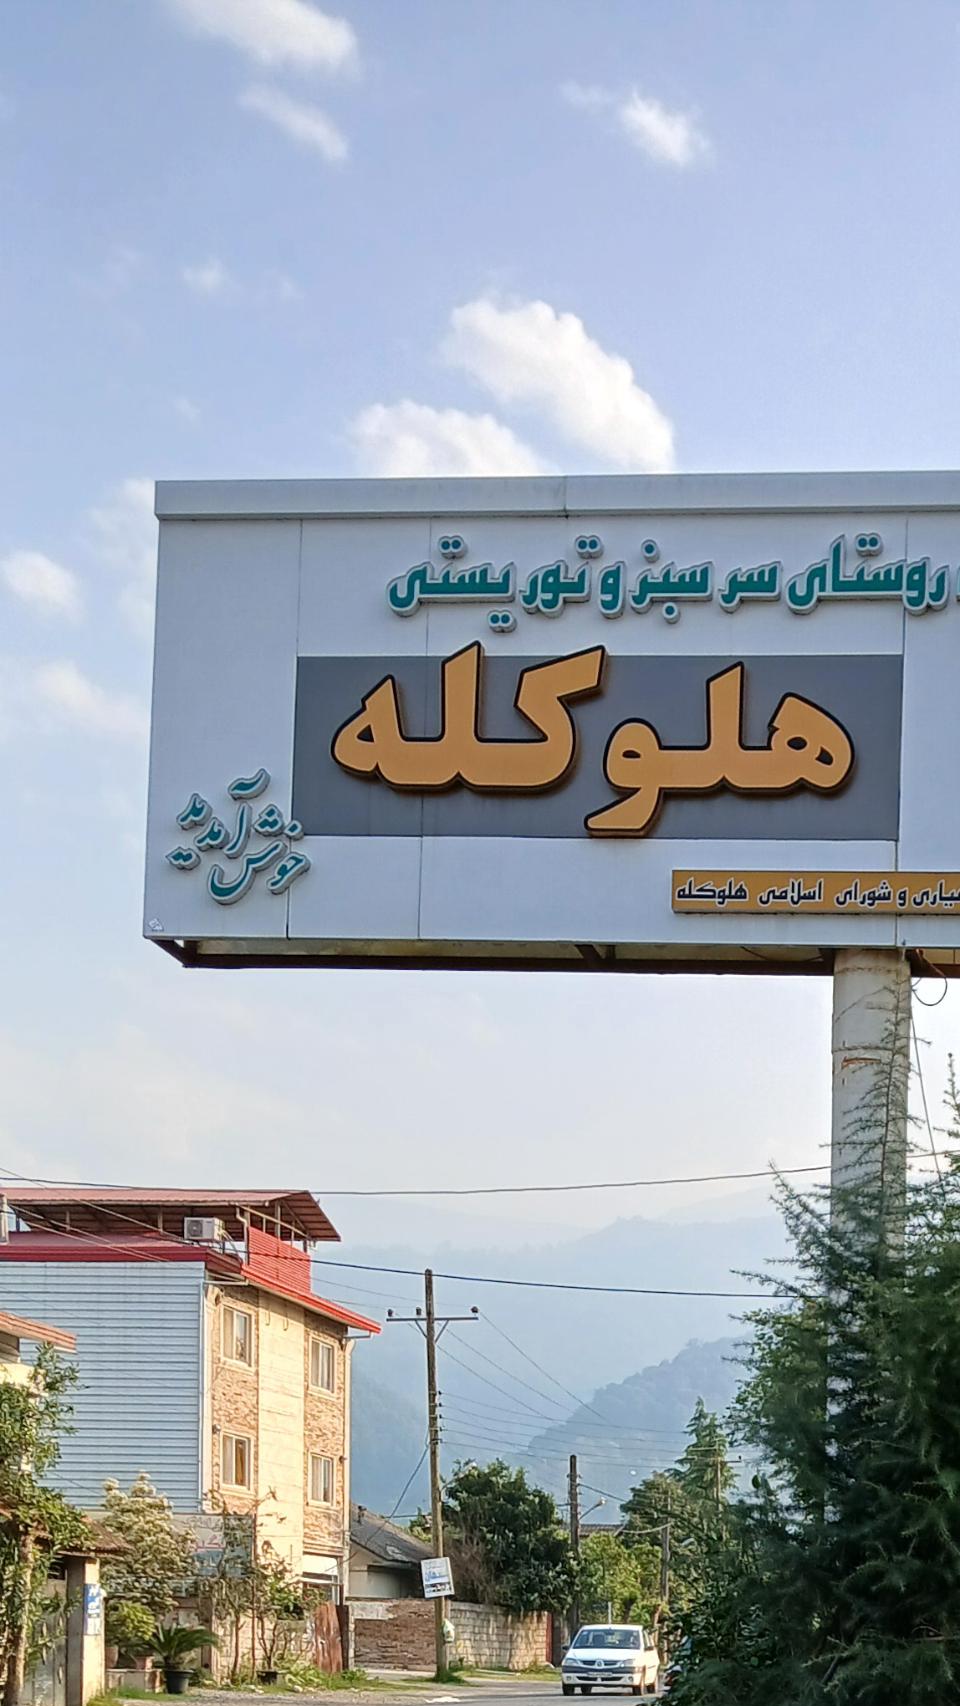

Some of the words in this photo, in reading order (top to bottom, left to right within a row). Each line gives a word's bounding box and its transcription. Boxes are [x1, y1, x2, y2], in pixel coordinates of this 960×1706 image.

[386, 535, 604, 634] توریستی
[598, 559, 626, 619] و
[786, 534, 949, 615] روستای
[330, 640, 857, 838] هلوکله
[675, 876, 748, 906] هلوکله
[757, 877, 823, 907] اسلامی
[834, 879, 893, 909] شورای
[897, 887, 909, 908] و
